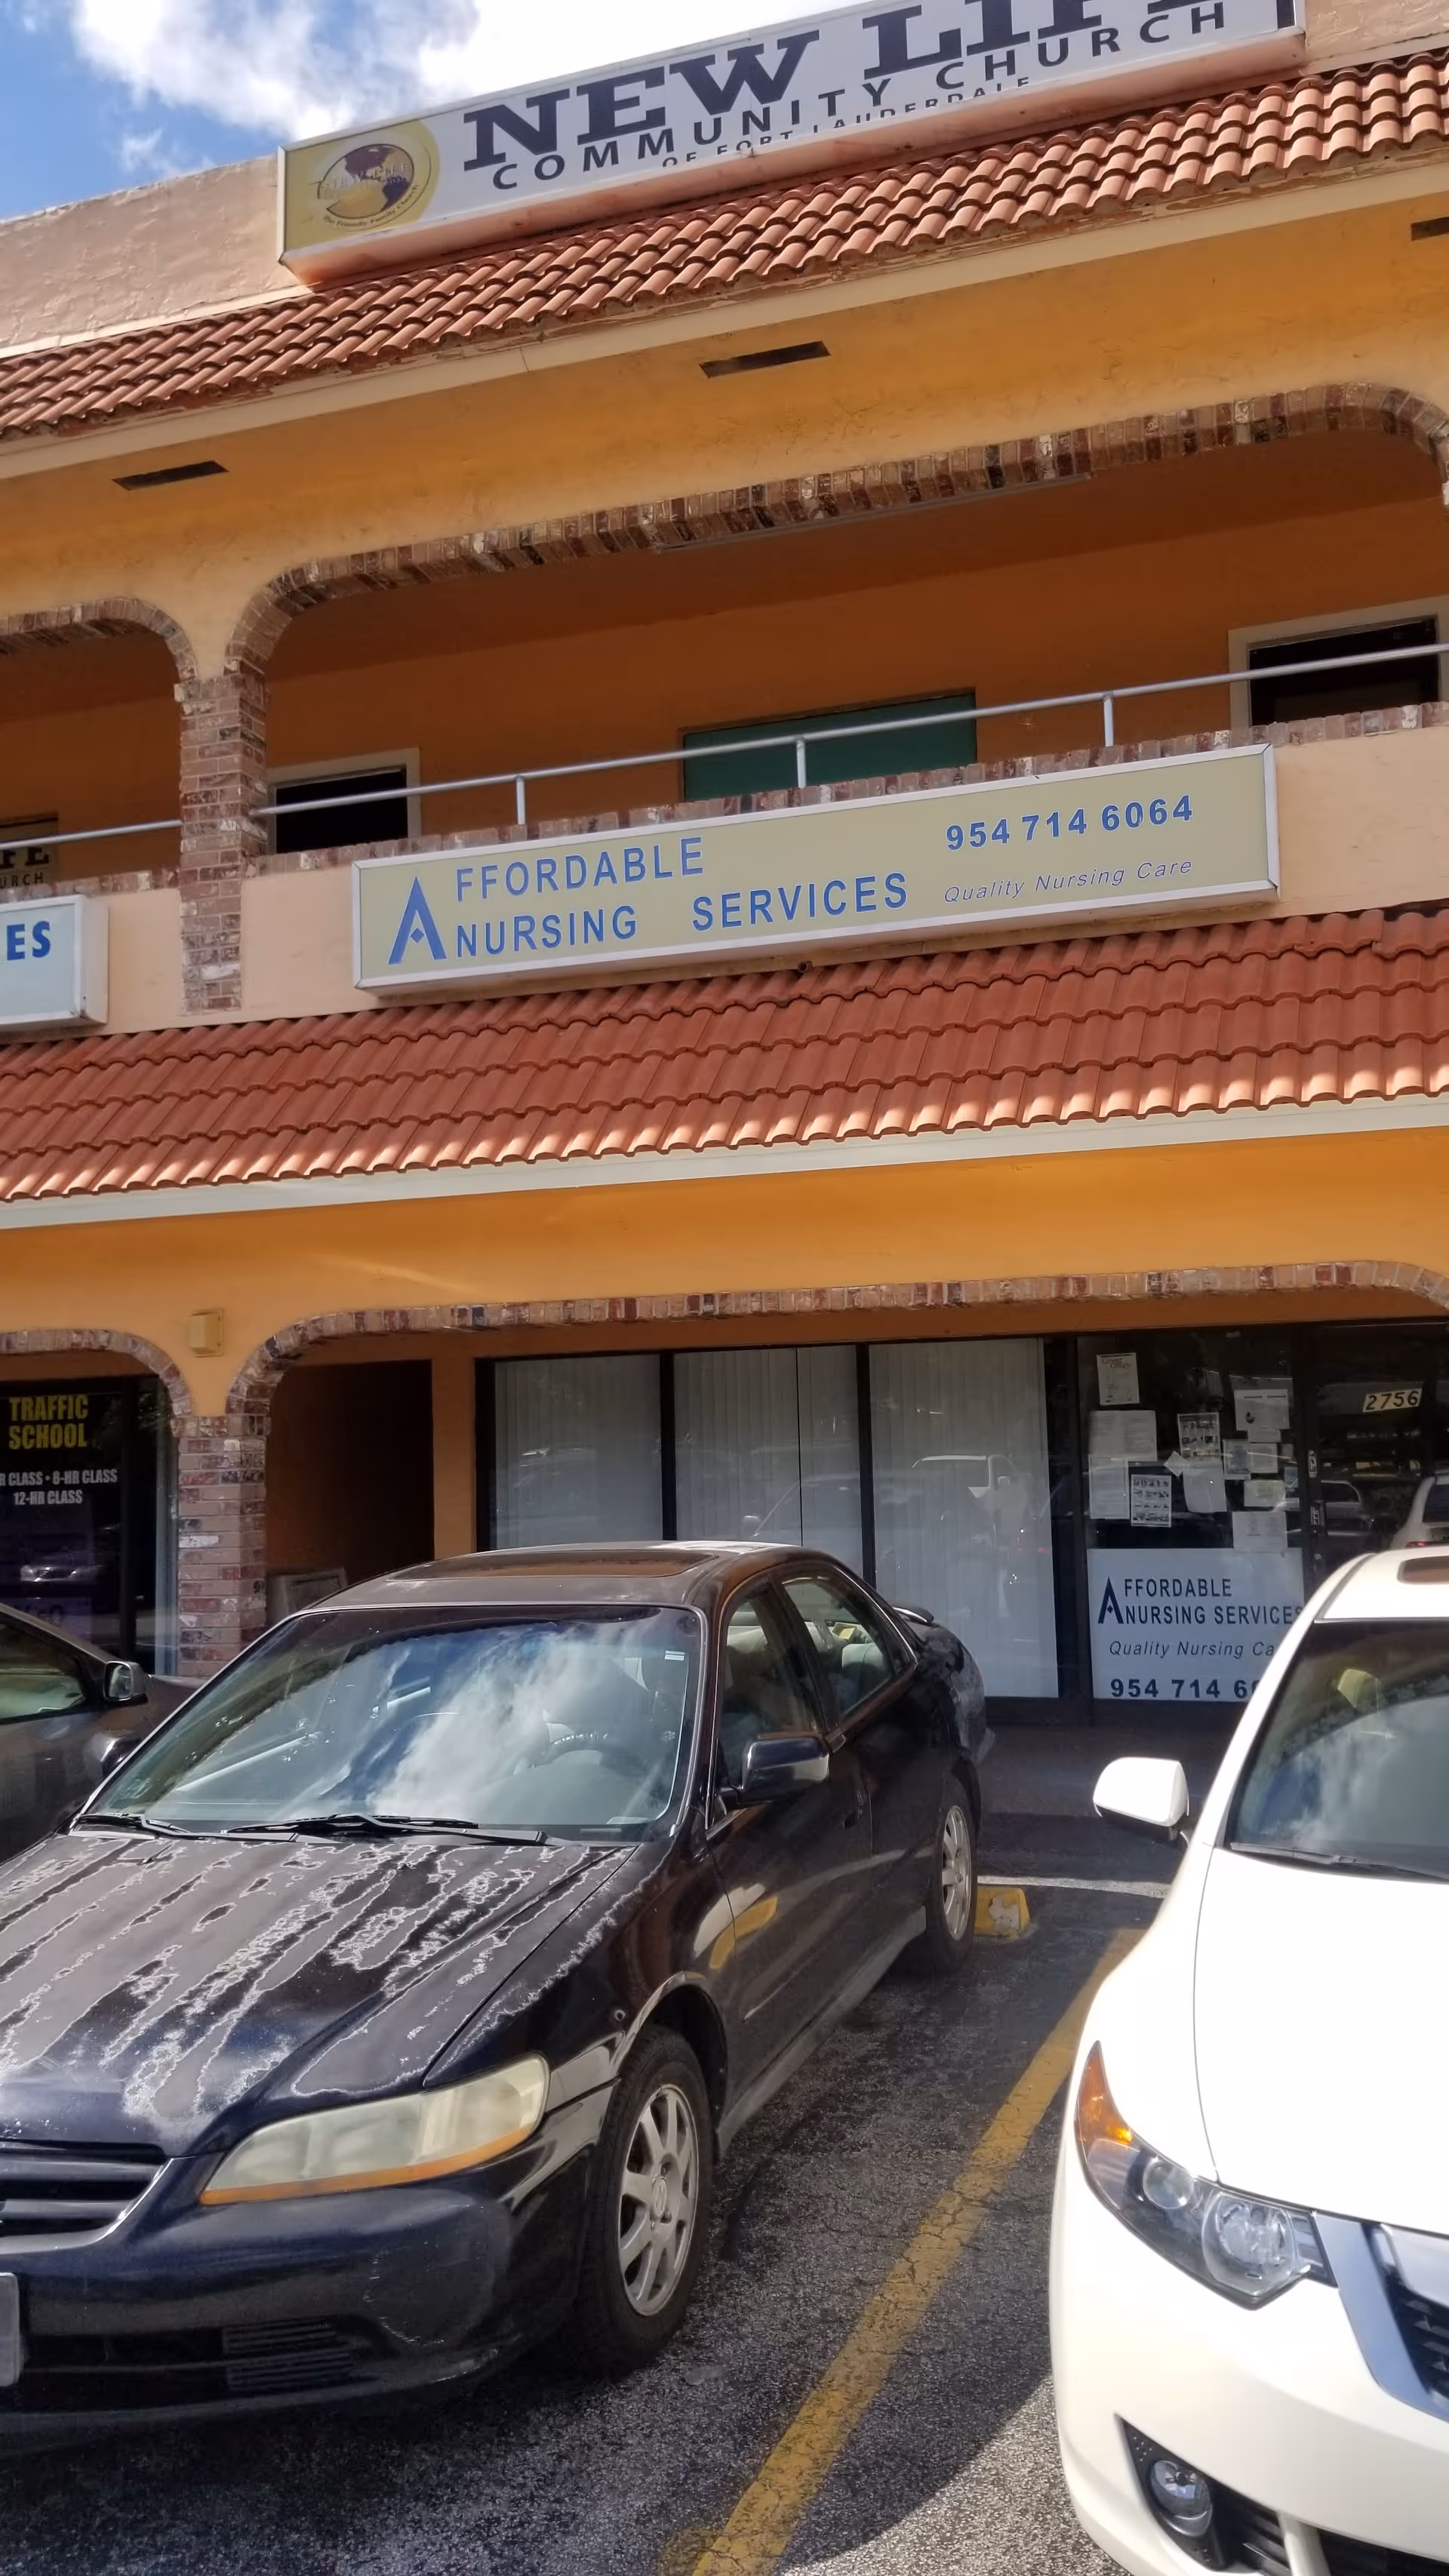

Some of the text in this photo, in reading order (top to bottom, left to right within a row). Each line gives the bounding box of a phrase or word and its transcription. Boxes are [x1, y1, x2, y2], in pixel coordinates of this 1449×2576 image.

[463, 0, 1217, 171] NEW LIF
[492, 78, 892, 189] COMMUNITY
[936, 7, 1224, 90] CHURCH
[663, 151, 697, 168] OF
[717, 130, 793, 156] FORT
[946, 795, 1192, 851] 954 714 6064
[944, 860, 1193, 903] Quality Nursing Care
[457, 873, 907, 958] NURSING SERVICES
[7, 920, 51, 961] ES
[9, 1395, 88, 1421] TRAFFIC
[1365, 1391, 1420, 1411] 2756
[9, 1423, 88, 1449] SCHOOL
[8, 1471, 43, 1486] CLASS
[82, 1470, 118, 1484] CLASS
[14, 1490, 83, 1505] 12-HR CLASS
[1125, 1605, 1205, 1624] NURSING
[1109, 1641, 1274, 1659] Quality Nursing Ca
[1110, 1679, 1159, 1698] 954
[1171, 1679, 1220, 1698] 714
